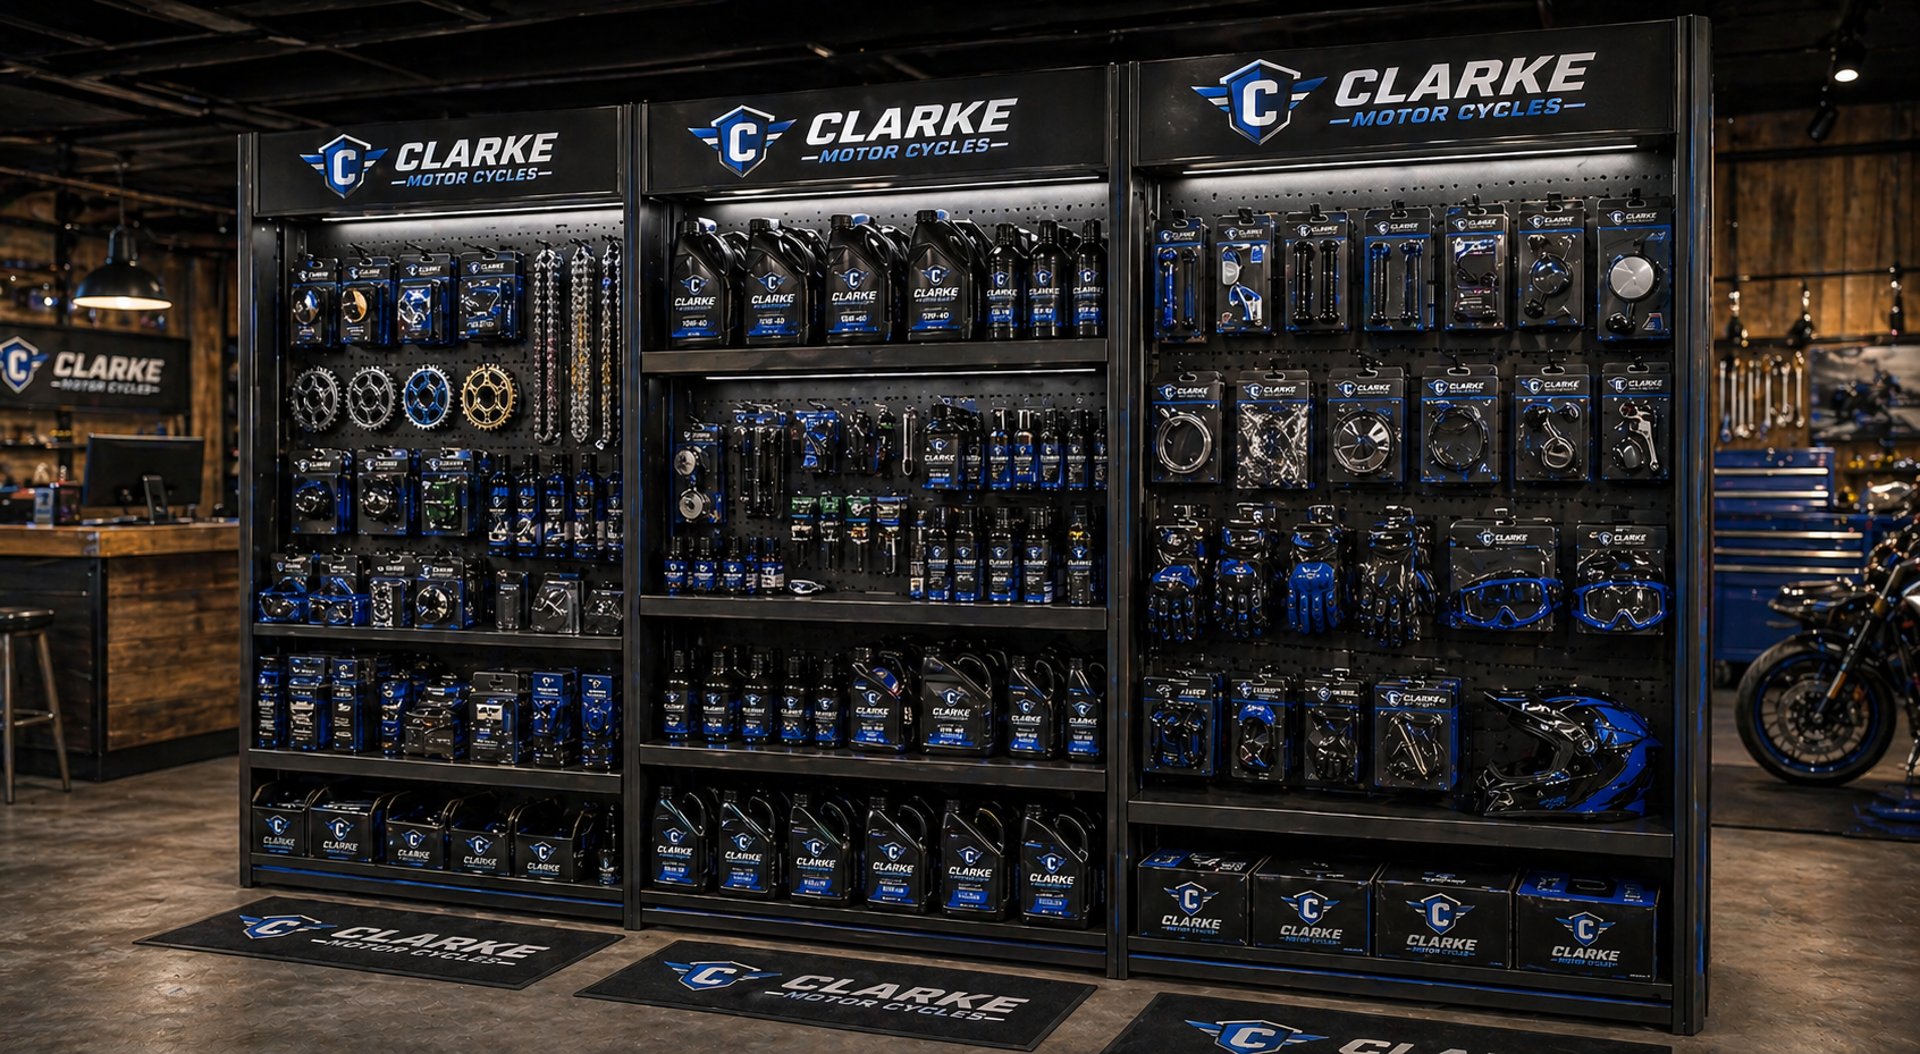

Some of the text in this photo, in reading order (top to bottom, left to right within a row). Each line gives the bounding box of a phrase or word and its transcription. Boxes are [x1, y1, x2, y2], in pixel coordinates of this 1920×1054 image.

[1335, 52, 1596, 107] CLARKE
[1242, 80, 1277, 126] C
[1351, 98, 1562, 127] MOTOR CYCLES
[806, 98, 1018, 145] CLARKE
[728, 123, 757, 162] C
[395, 132, 559, 171] CLARKE
[819, 138, 990, 163] MOTOR CYCLES
[334, 150, 356, 185] C
[406, 168, 537, 187] MOTOR CYCLES
[1626, 212, 1657, 220] CLARKE
[850, 272, 858, 285] C
[932, 269, 940, 283] C
[691, 279, 699, 291] C
[768, 277, 776, 289] C
[832, 291, 877, 301] CLARKE
[914, 287, 959, 298] CLARKE
[675, 297, 716, 305] CLARKE
[751, 294, 795, 304] CLARKE
[7, 349, 27, 381] C
[53, 351, 165, 382] CLARKE
[1176, 387, 1209, 395] CLARKE
[1450, 382, 1484, 390] CLARKE
[1495, 534, 1528, 542] CLARKE
[1614, 534, 1646, 542] CLARKE
[869, 693, 876, 703] C
[947, 693, 954, 704] C
[932, 708, 971, 717] CLARKE
[274, 820, 281, 832] C
[335, 824, 344, 836] C
[410, 835, 417, 845] C
[671, 832, 678, 842] C
[739, 837, 747, 848] C
[323, 841, 358, 851] CLARKE
[476, 840, 483, 852] C
[812, 842, 819, 854] C
[398, 849, 430, 860] CLARKE
[539, 847, 546, 858] C
[725, 851, 762, 861] CLARKE
[889, 847, 898, 859] C
[965, 851, 974, 863] C
[527, 862, 560, 872] CLARKE
[796, 857, 836, 868] CLARKE
[873, 862, 914, 873] CLARKE
[1047, 858, 1056, 869] C
[949, 866, 992, 878] CLARKE
[1029, 874, 1075, 885] CLARKE
[1184, 890, 1197, 909] C
[1304, 899, 1317, 918] C
[1432, 903, 1449, 926] C
[255, 920, 299, 935] C
[1161, 915, 1222, 929] CLARKE
[1280, 925, 1343, 939] CLARKE
[1578, 920, 1593, 940] C
[331, 927, 550, 959] CLARKE
[1406, 935, 1477, 951] CLARKE
[328, 940, 496, 964] MOTOR CYCLES
[1551, 946, 1620, 961] CLARKE
[693, 967, 736, 985] C
[782, 975, 1029, 1013] CLARKE
[784, 990, 987, 1020] MOTOR CYCLES
